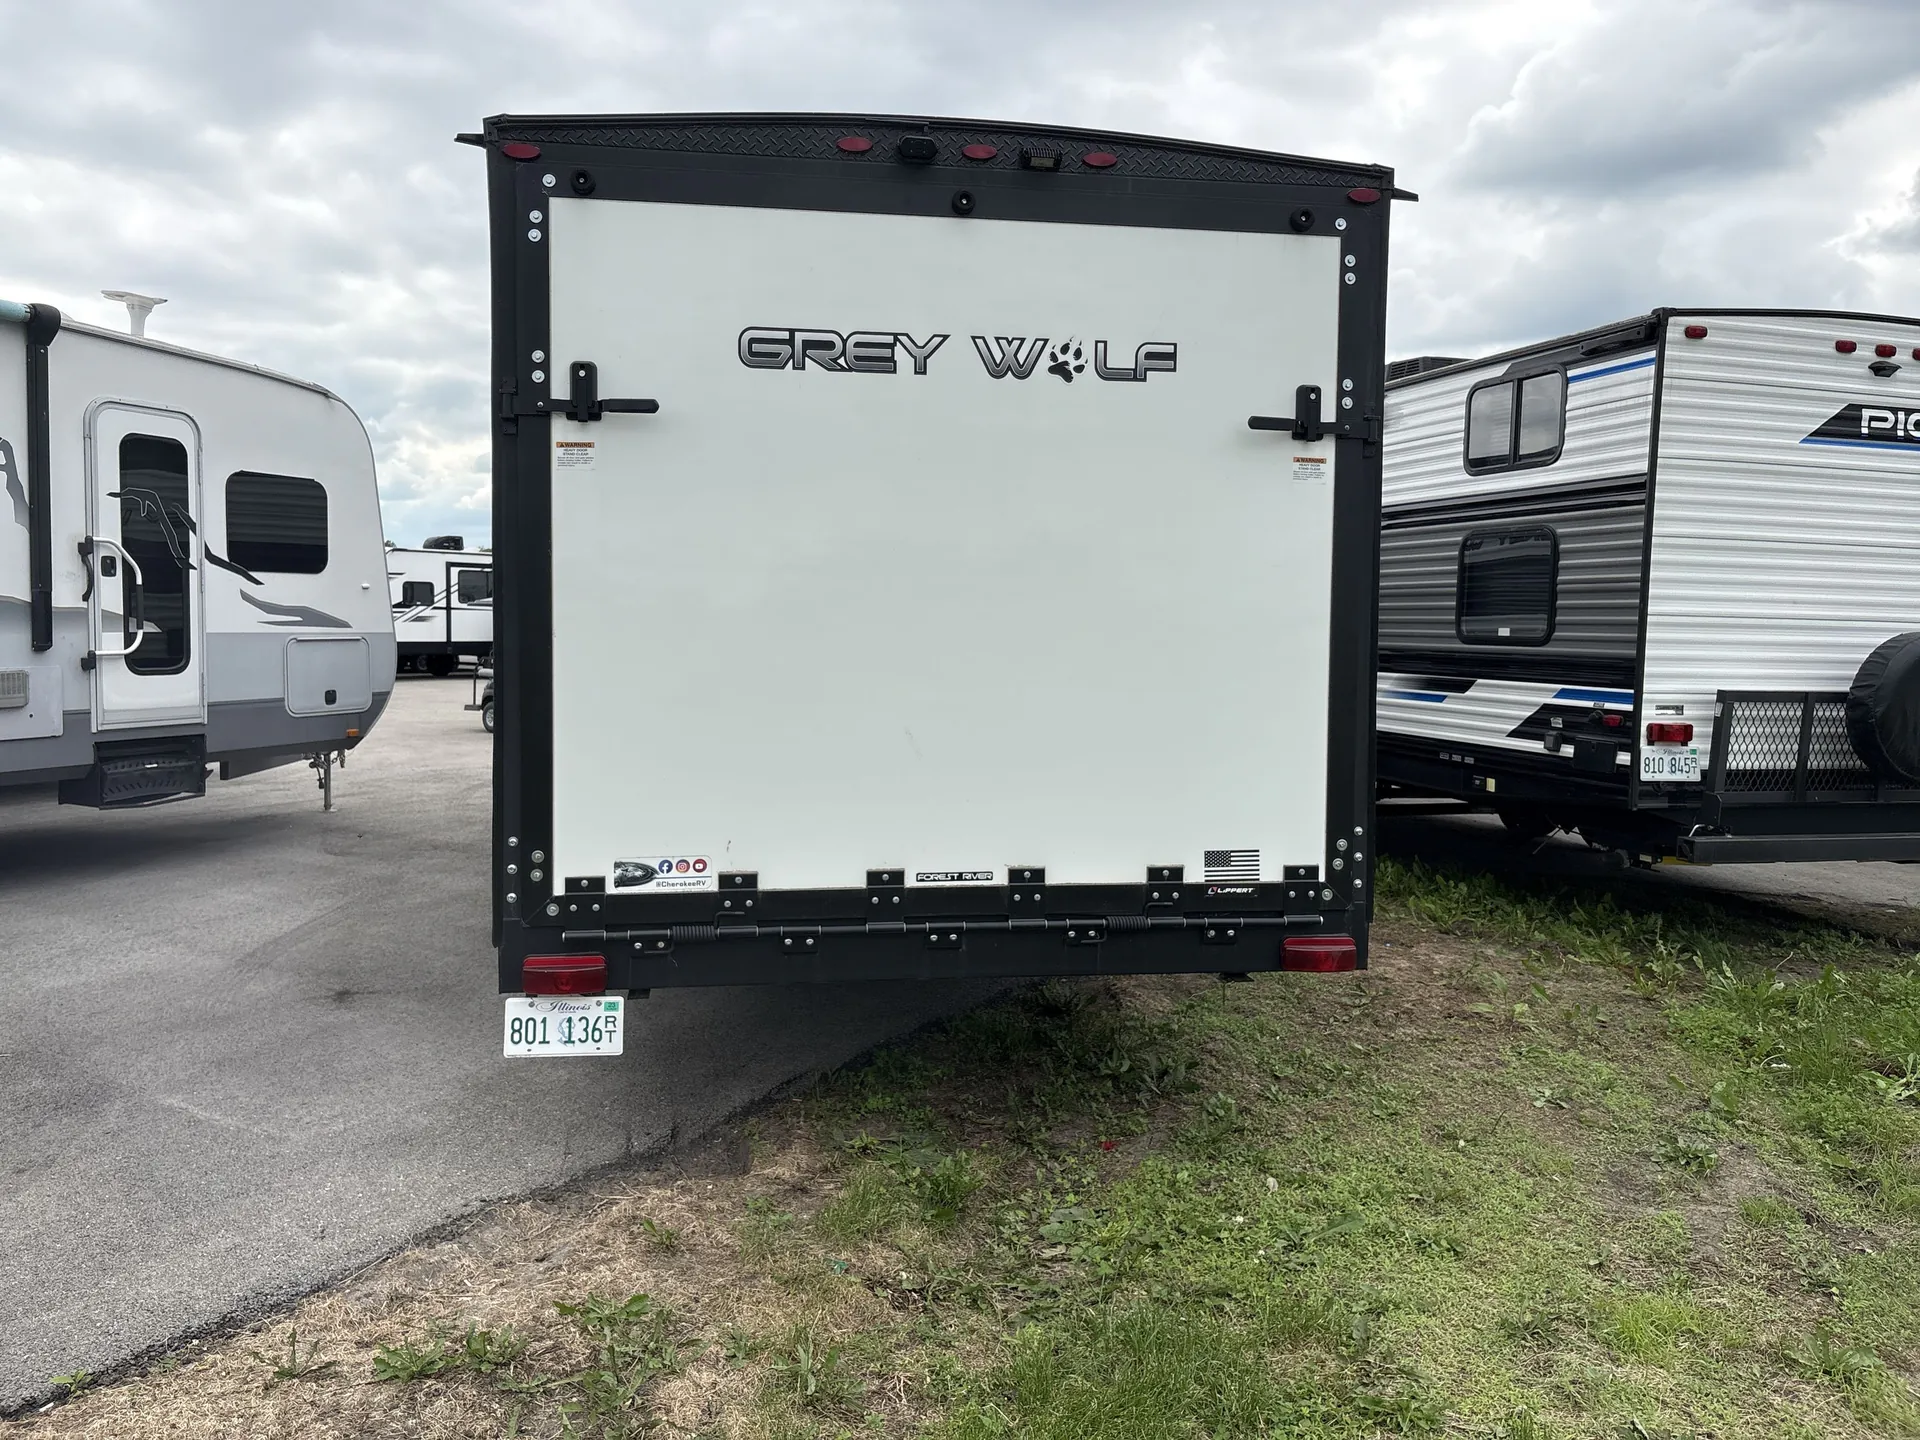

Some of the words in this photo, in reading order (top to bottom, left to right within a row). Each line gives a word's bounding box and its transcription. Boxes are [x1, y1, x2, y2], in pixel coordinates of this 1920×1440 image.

[738, 326, 951, 376] GREY
[1644, 757, 1665, 774] 810
[1670, 757, 1691, 774] 845
[917, 873, 960, 881] FOREST
[962, 872, 993, 880] RIVER
[536, 1000, 592, 1012] Illinois
[510, 1016, 550, 1045] 801
[564, 1015, 603, 1044] 136
